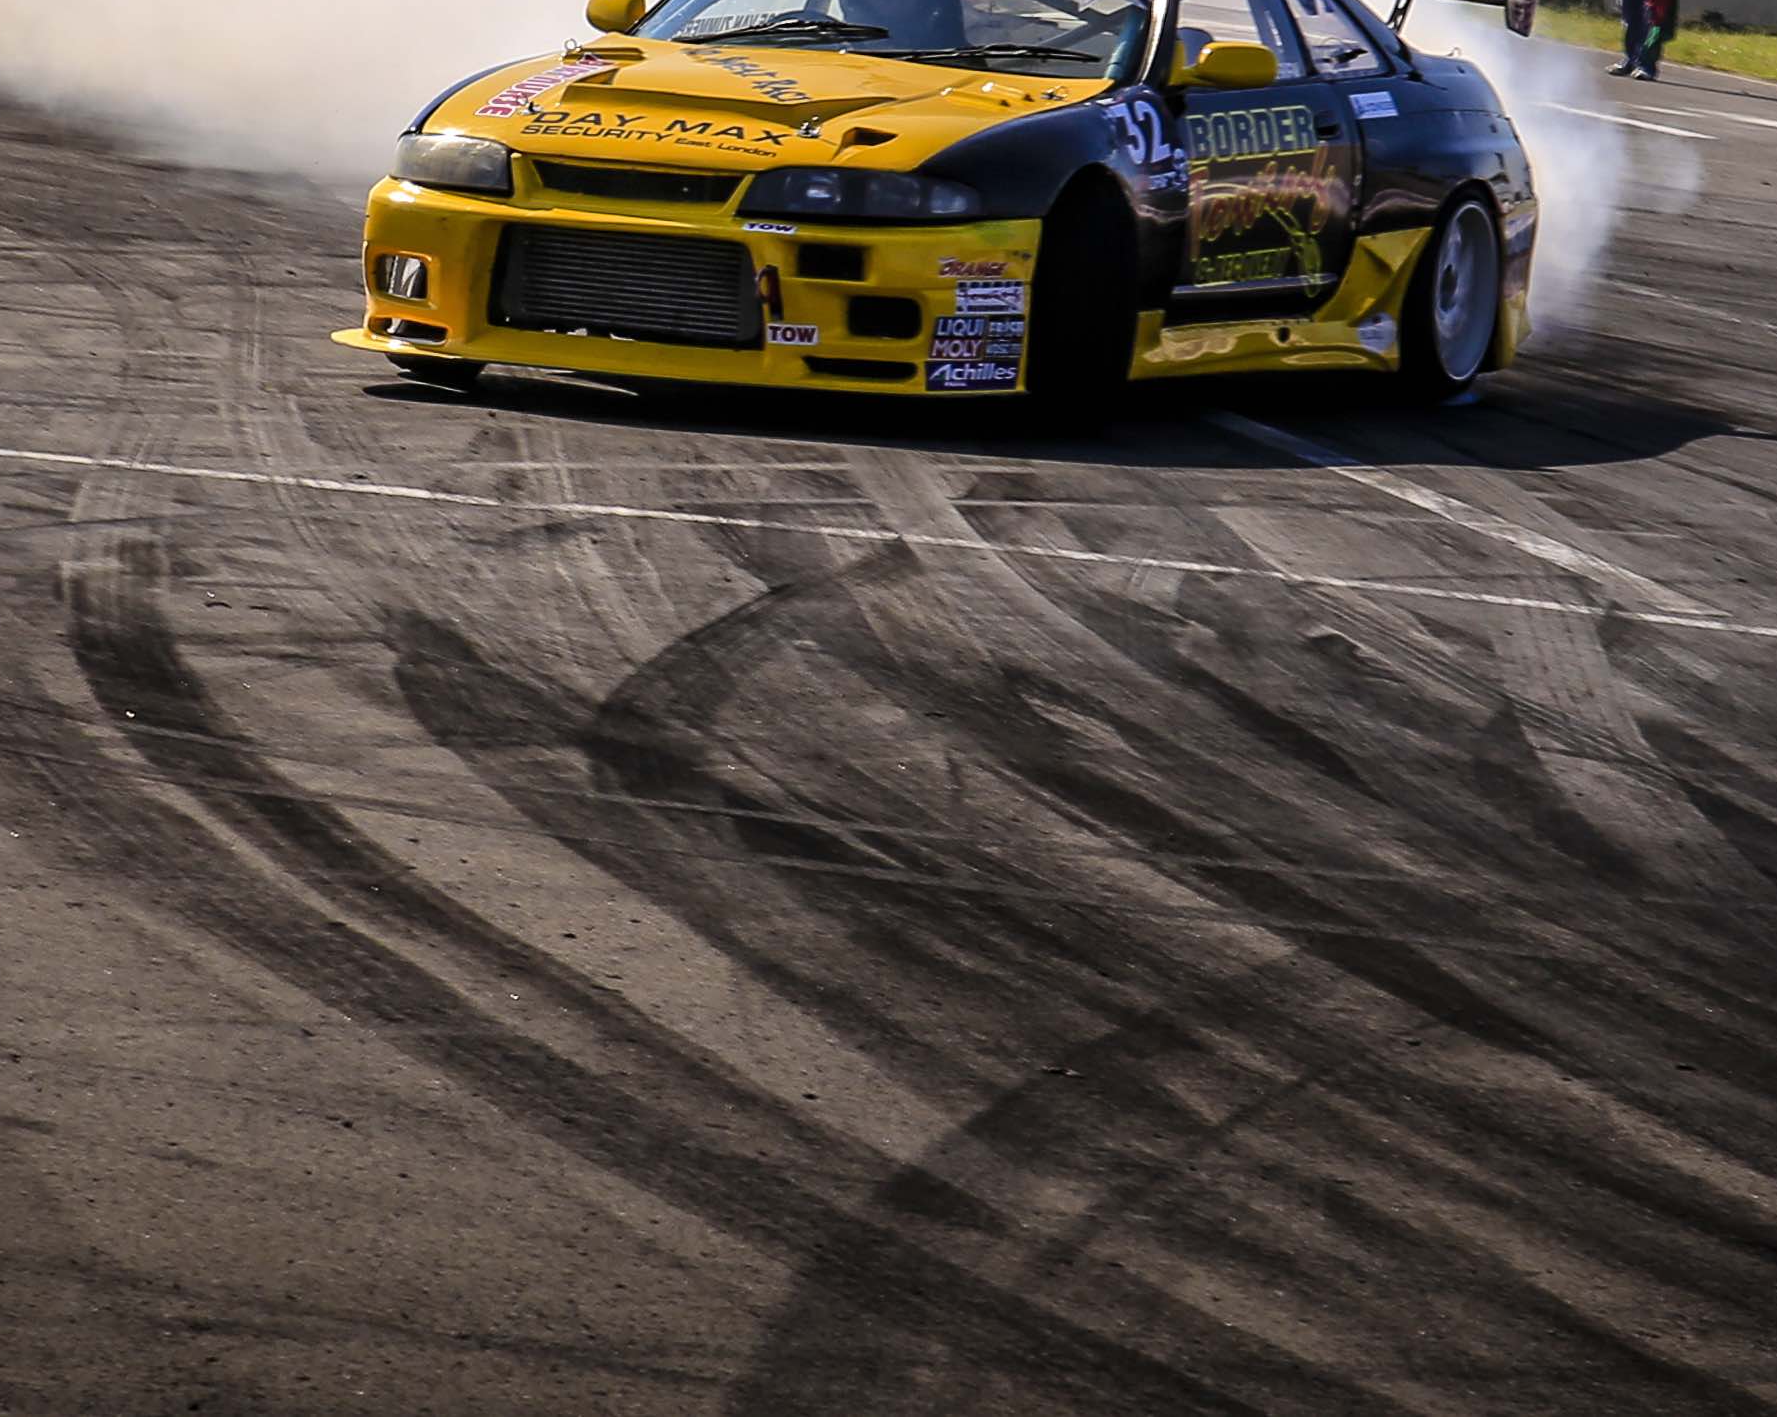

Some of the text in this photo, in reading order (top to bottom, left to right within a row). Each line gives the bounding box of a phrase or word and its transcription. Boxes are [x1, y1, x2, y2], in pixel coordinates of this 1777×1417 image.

[532, 111, 793, 146] DAY MAX
[1103, 100, 1170, 165] 32
[1186, 105, 1318, 165] BORDER
[521, 125, 778, 158] SECURITY East London
[746, 223, 794, 232] TOW
[768, 325, 816, 343] TOW
[936, 318, 984, 337] LIQUI
[931, 339, 983, 358] MOLY
[929, 363, 1017, 381] Achilles
